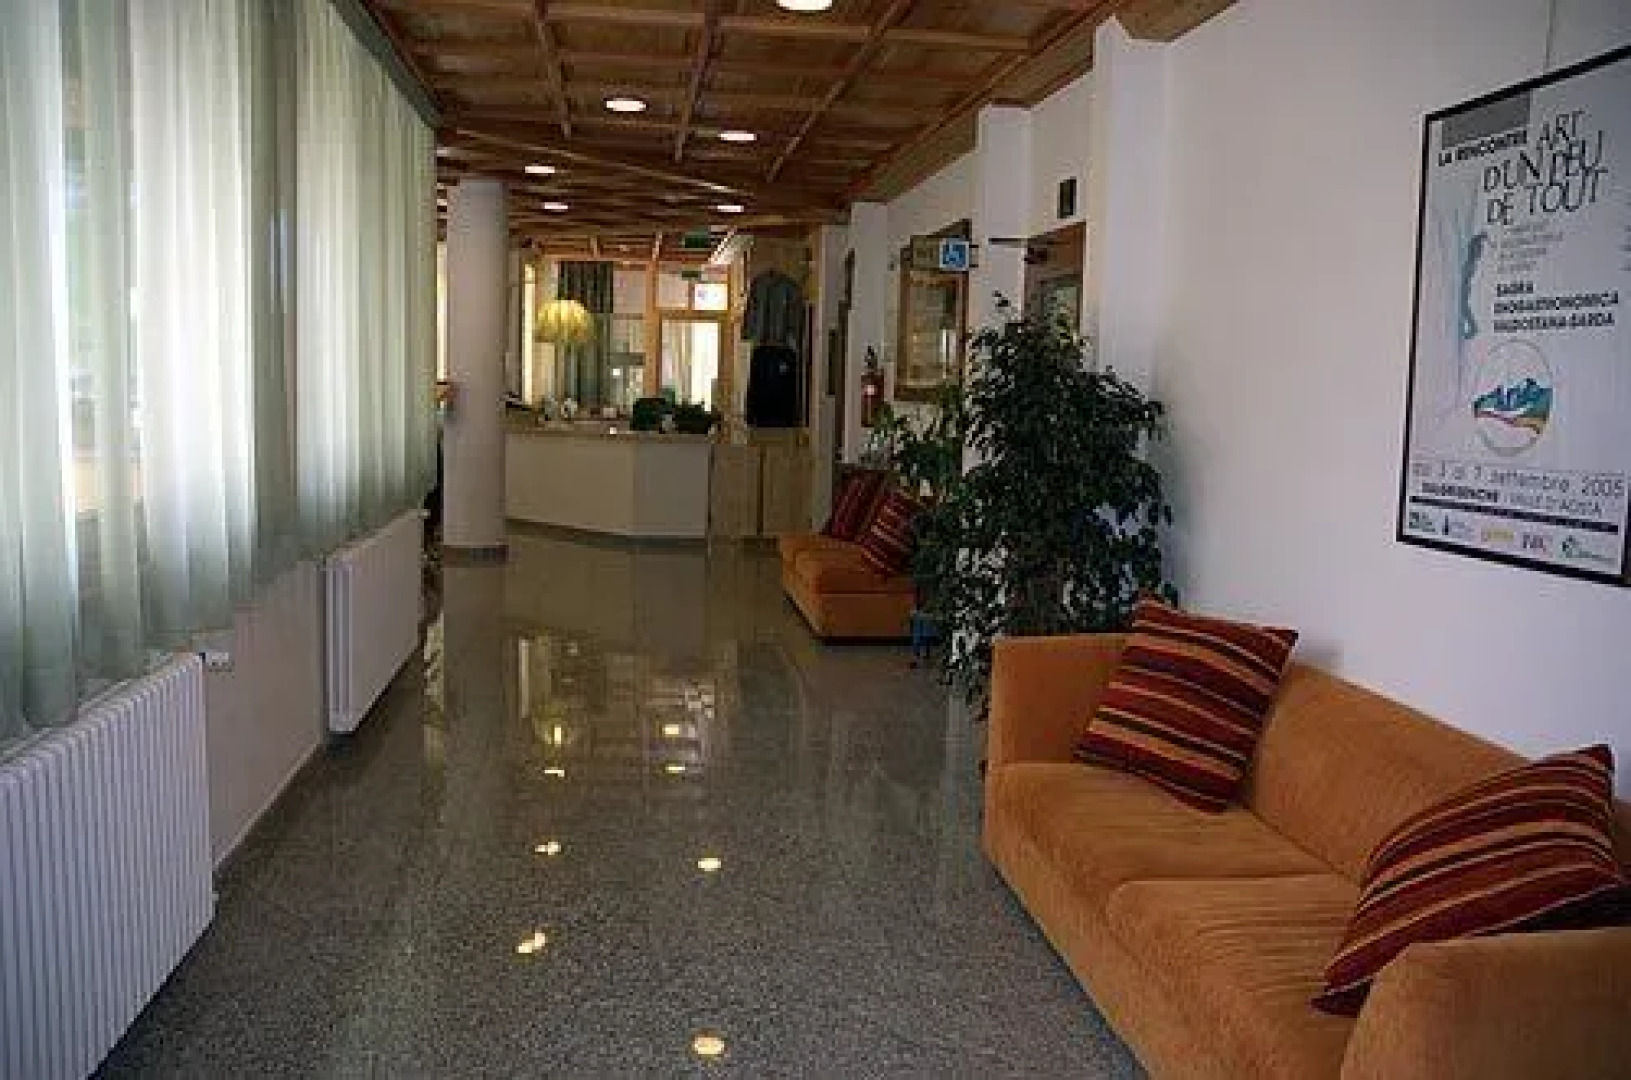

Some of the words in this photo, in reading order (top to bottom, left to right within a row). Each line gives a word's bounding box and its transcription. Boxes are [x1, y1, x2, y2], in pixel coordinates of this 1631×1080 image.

[1538, 109, 1585, 151] ART
[1487, 192, 1514, 226] DE
[1525, 167, 1608, 215] TOUT
[1581, 476, 1624, 498] 2005
